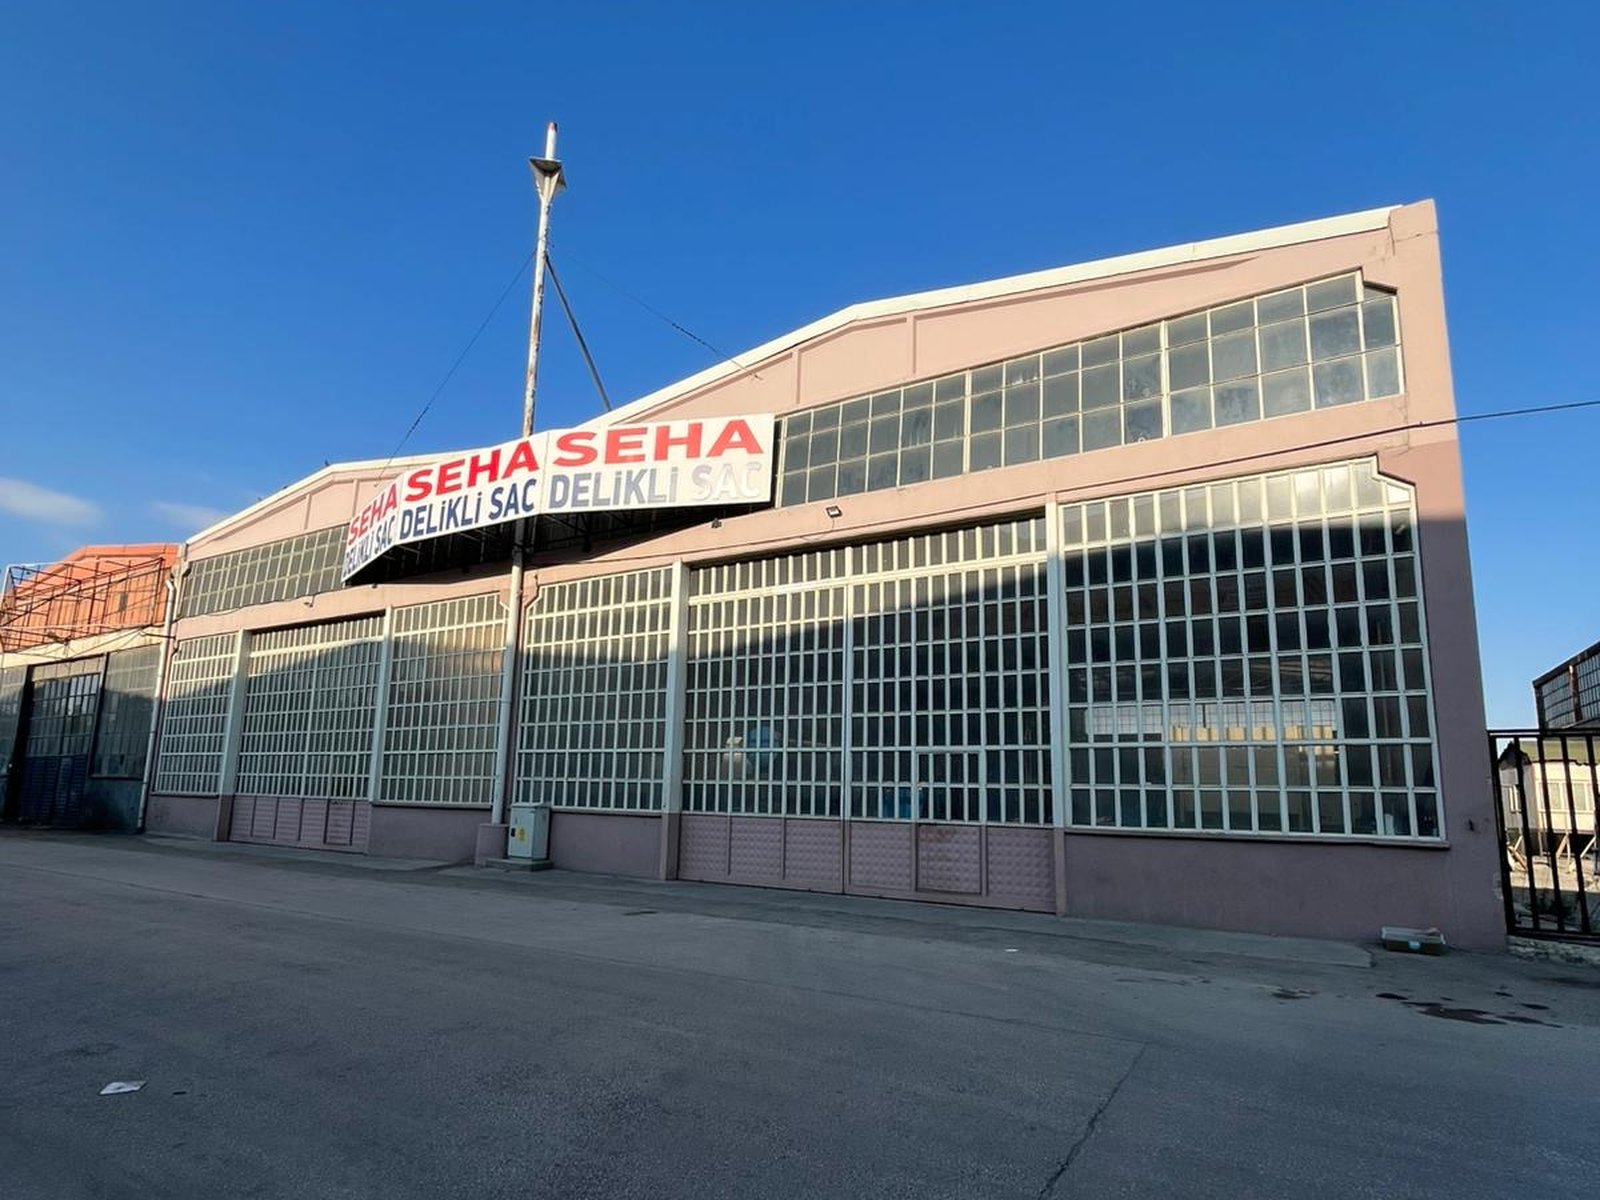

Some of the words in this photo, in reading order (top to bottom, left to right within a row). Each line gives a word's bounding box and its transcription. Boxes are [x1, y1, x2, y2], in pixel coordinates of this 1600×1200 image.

[552, 419, 764, 467] SEHA
[404, 440, 540, 503] SEHA
[690, 461, 763, 502] SAC
[348, 483, 397, 546] SEHA
[488, 478, 538, 521] SAC
